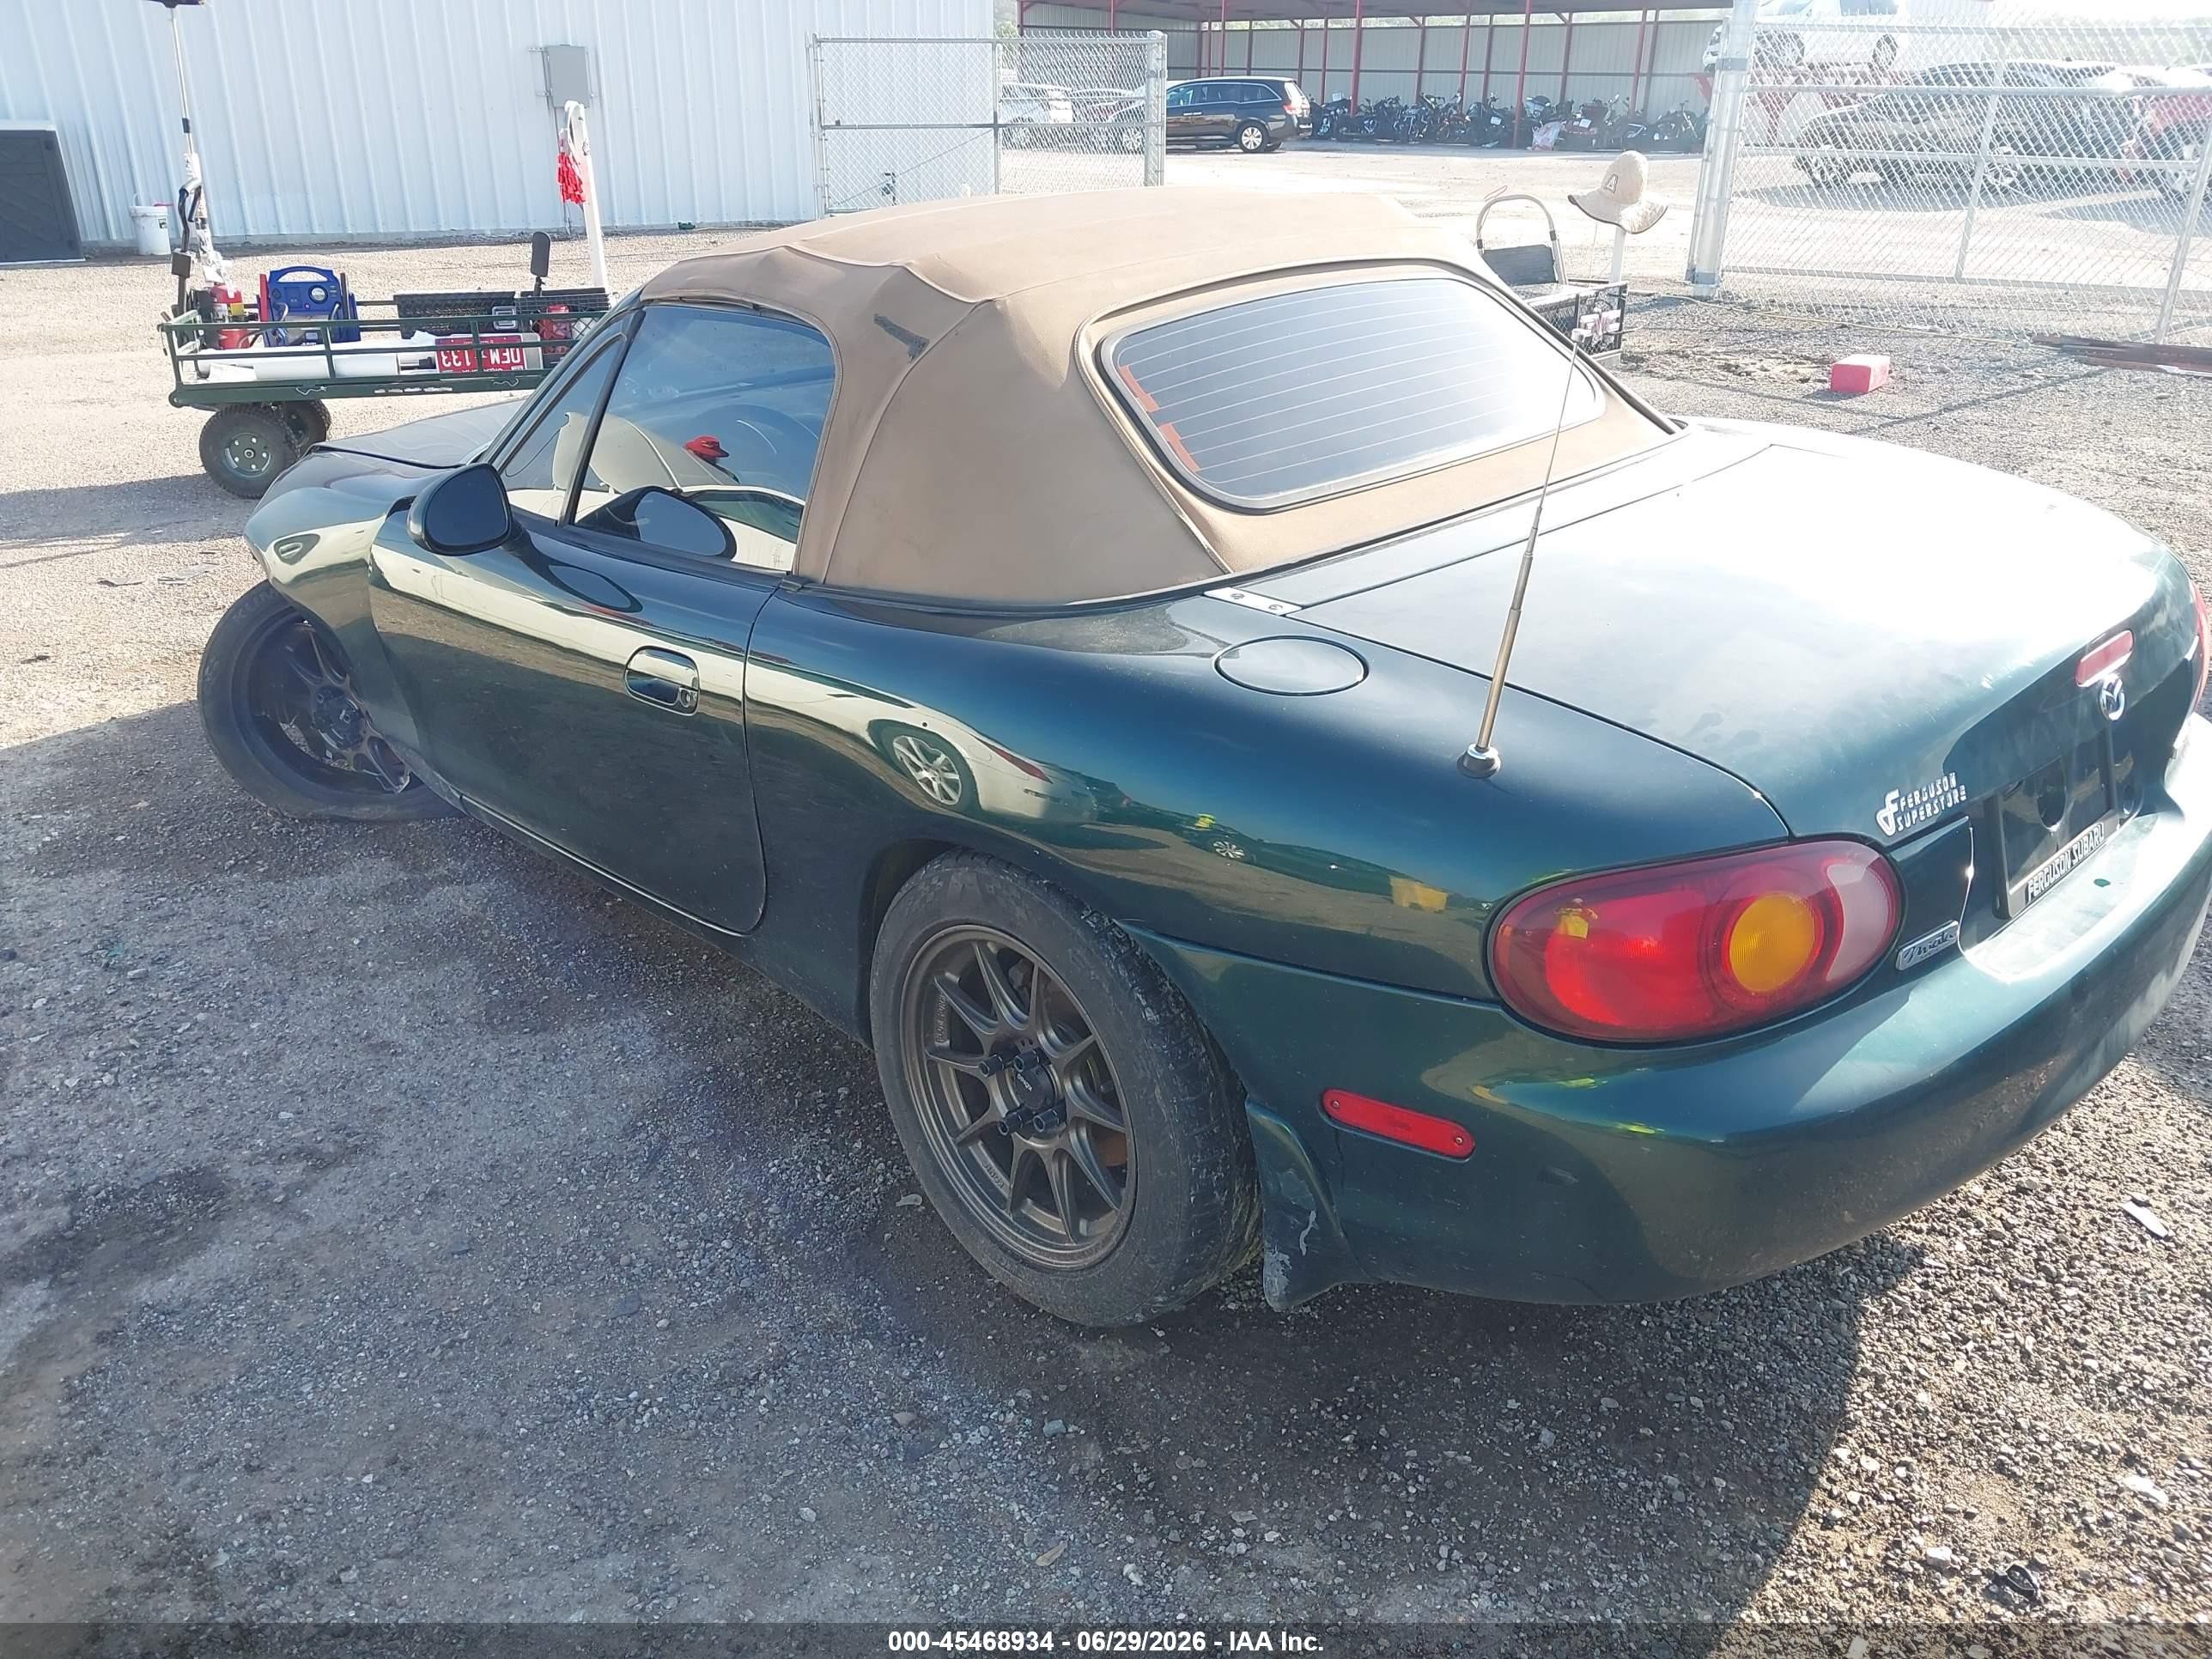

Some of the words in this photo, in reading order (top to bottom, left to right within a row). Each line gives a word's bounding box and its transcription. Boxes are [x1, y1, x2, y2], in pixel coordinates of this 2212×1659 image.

[1896, 785, 1967, 832] SUPERSTORE
[1899, 772, 1957, 812] FERGUSON
[2027, 849, 2071, 902] FERGUSON
[2071, 823, 2105, 865] SUBARU
